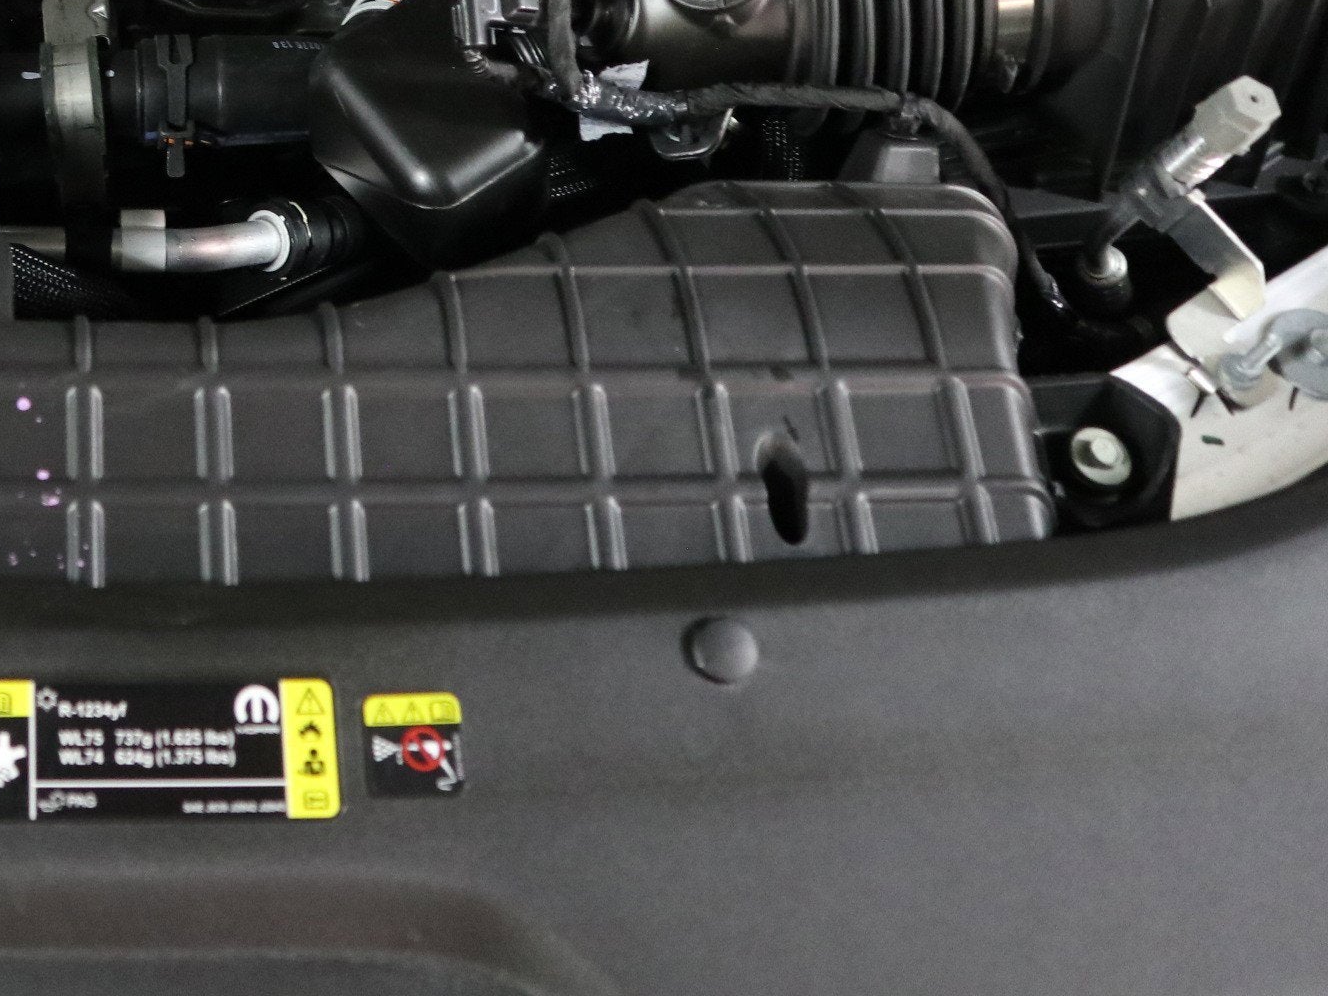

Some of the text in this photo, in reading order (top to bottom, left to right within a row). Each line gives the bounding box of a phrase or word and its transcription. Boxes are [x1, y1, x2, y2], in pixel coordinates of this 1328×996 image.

[57, 698, 128, 721] R-1234yf
[57, 727, 104, 746] WL75
[114, 727, 154, 749] 737g
[57, 747, 104, 765] WL74
[114, 747, 154, 768] 624g
